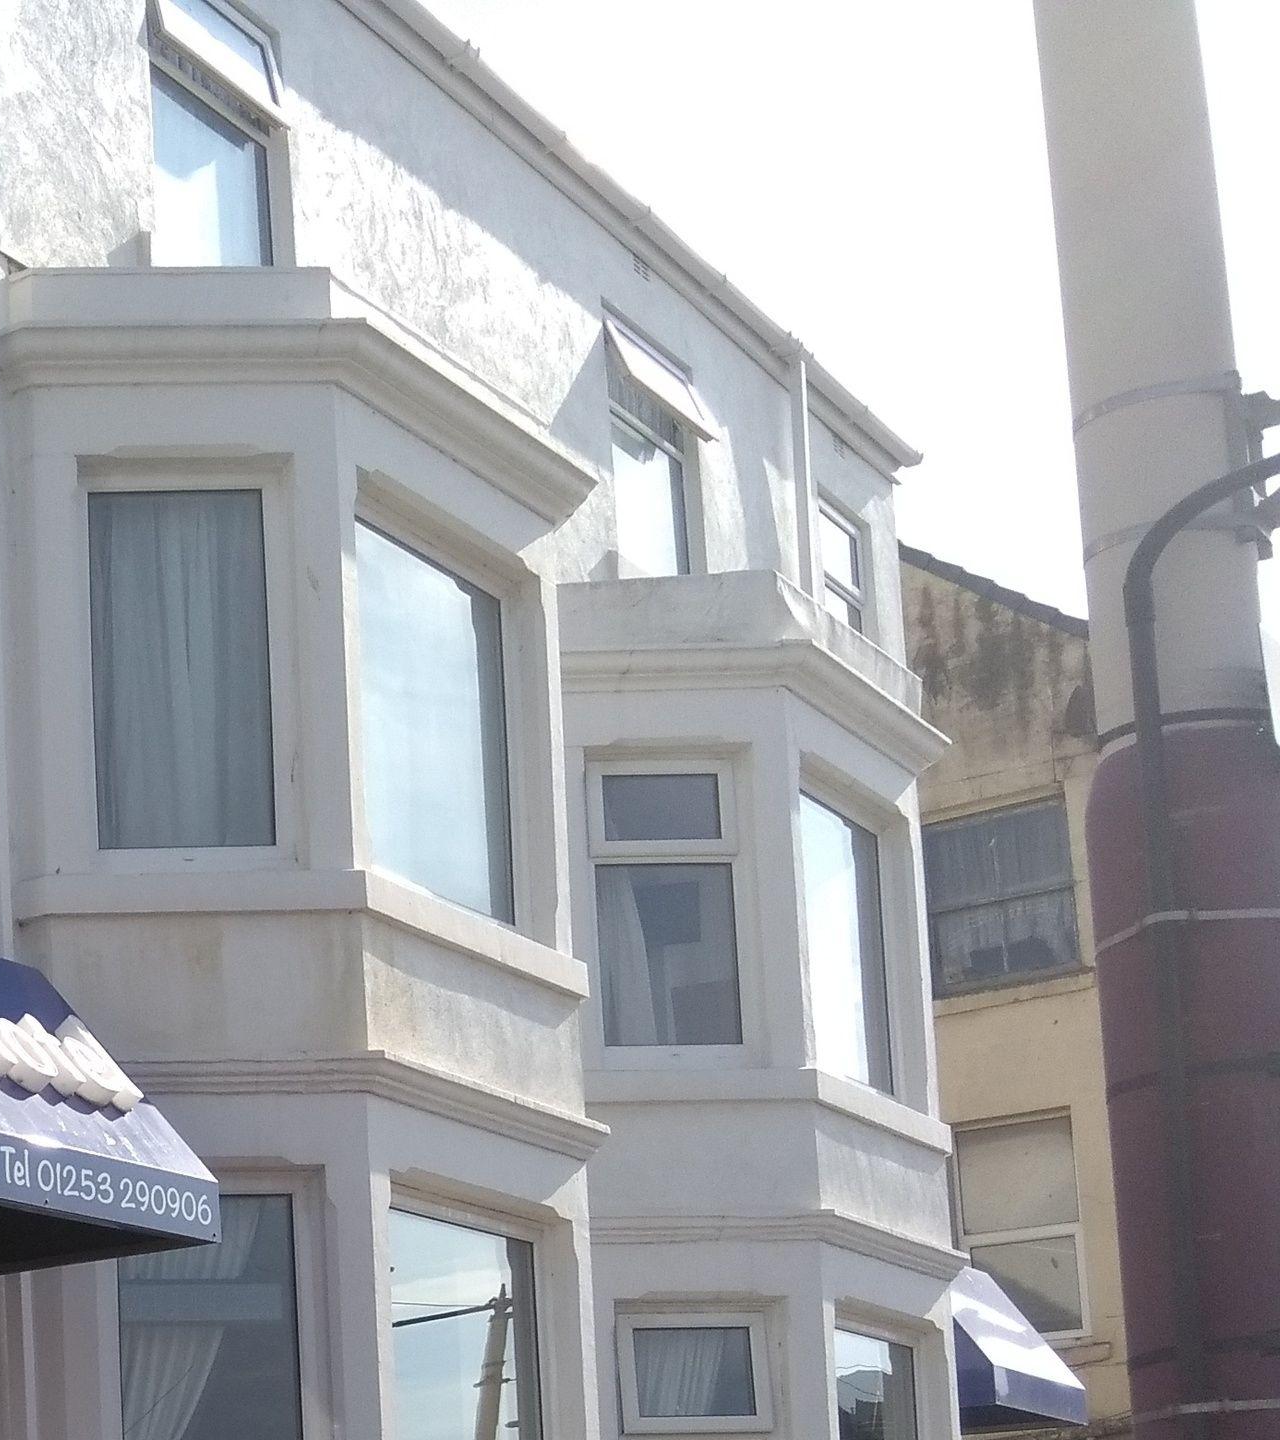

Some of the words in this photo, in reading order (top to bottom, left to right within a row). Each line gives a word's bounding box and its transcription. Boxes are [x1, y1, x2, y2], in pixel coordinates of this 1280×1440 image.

[0, 1145, 31, 1188] Tel
[37, 1159, 114, 1204] 01253
[119, 1177, 212, 1225] 290906
